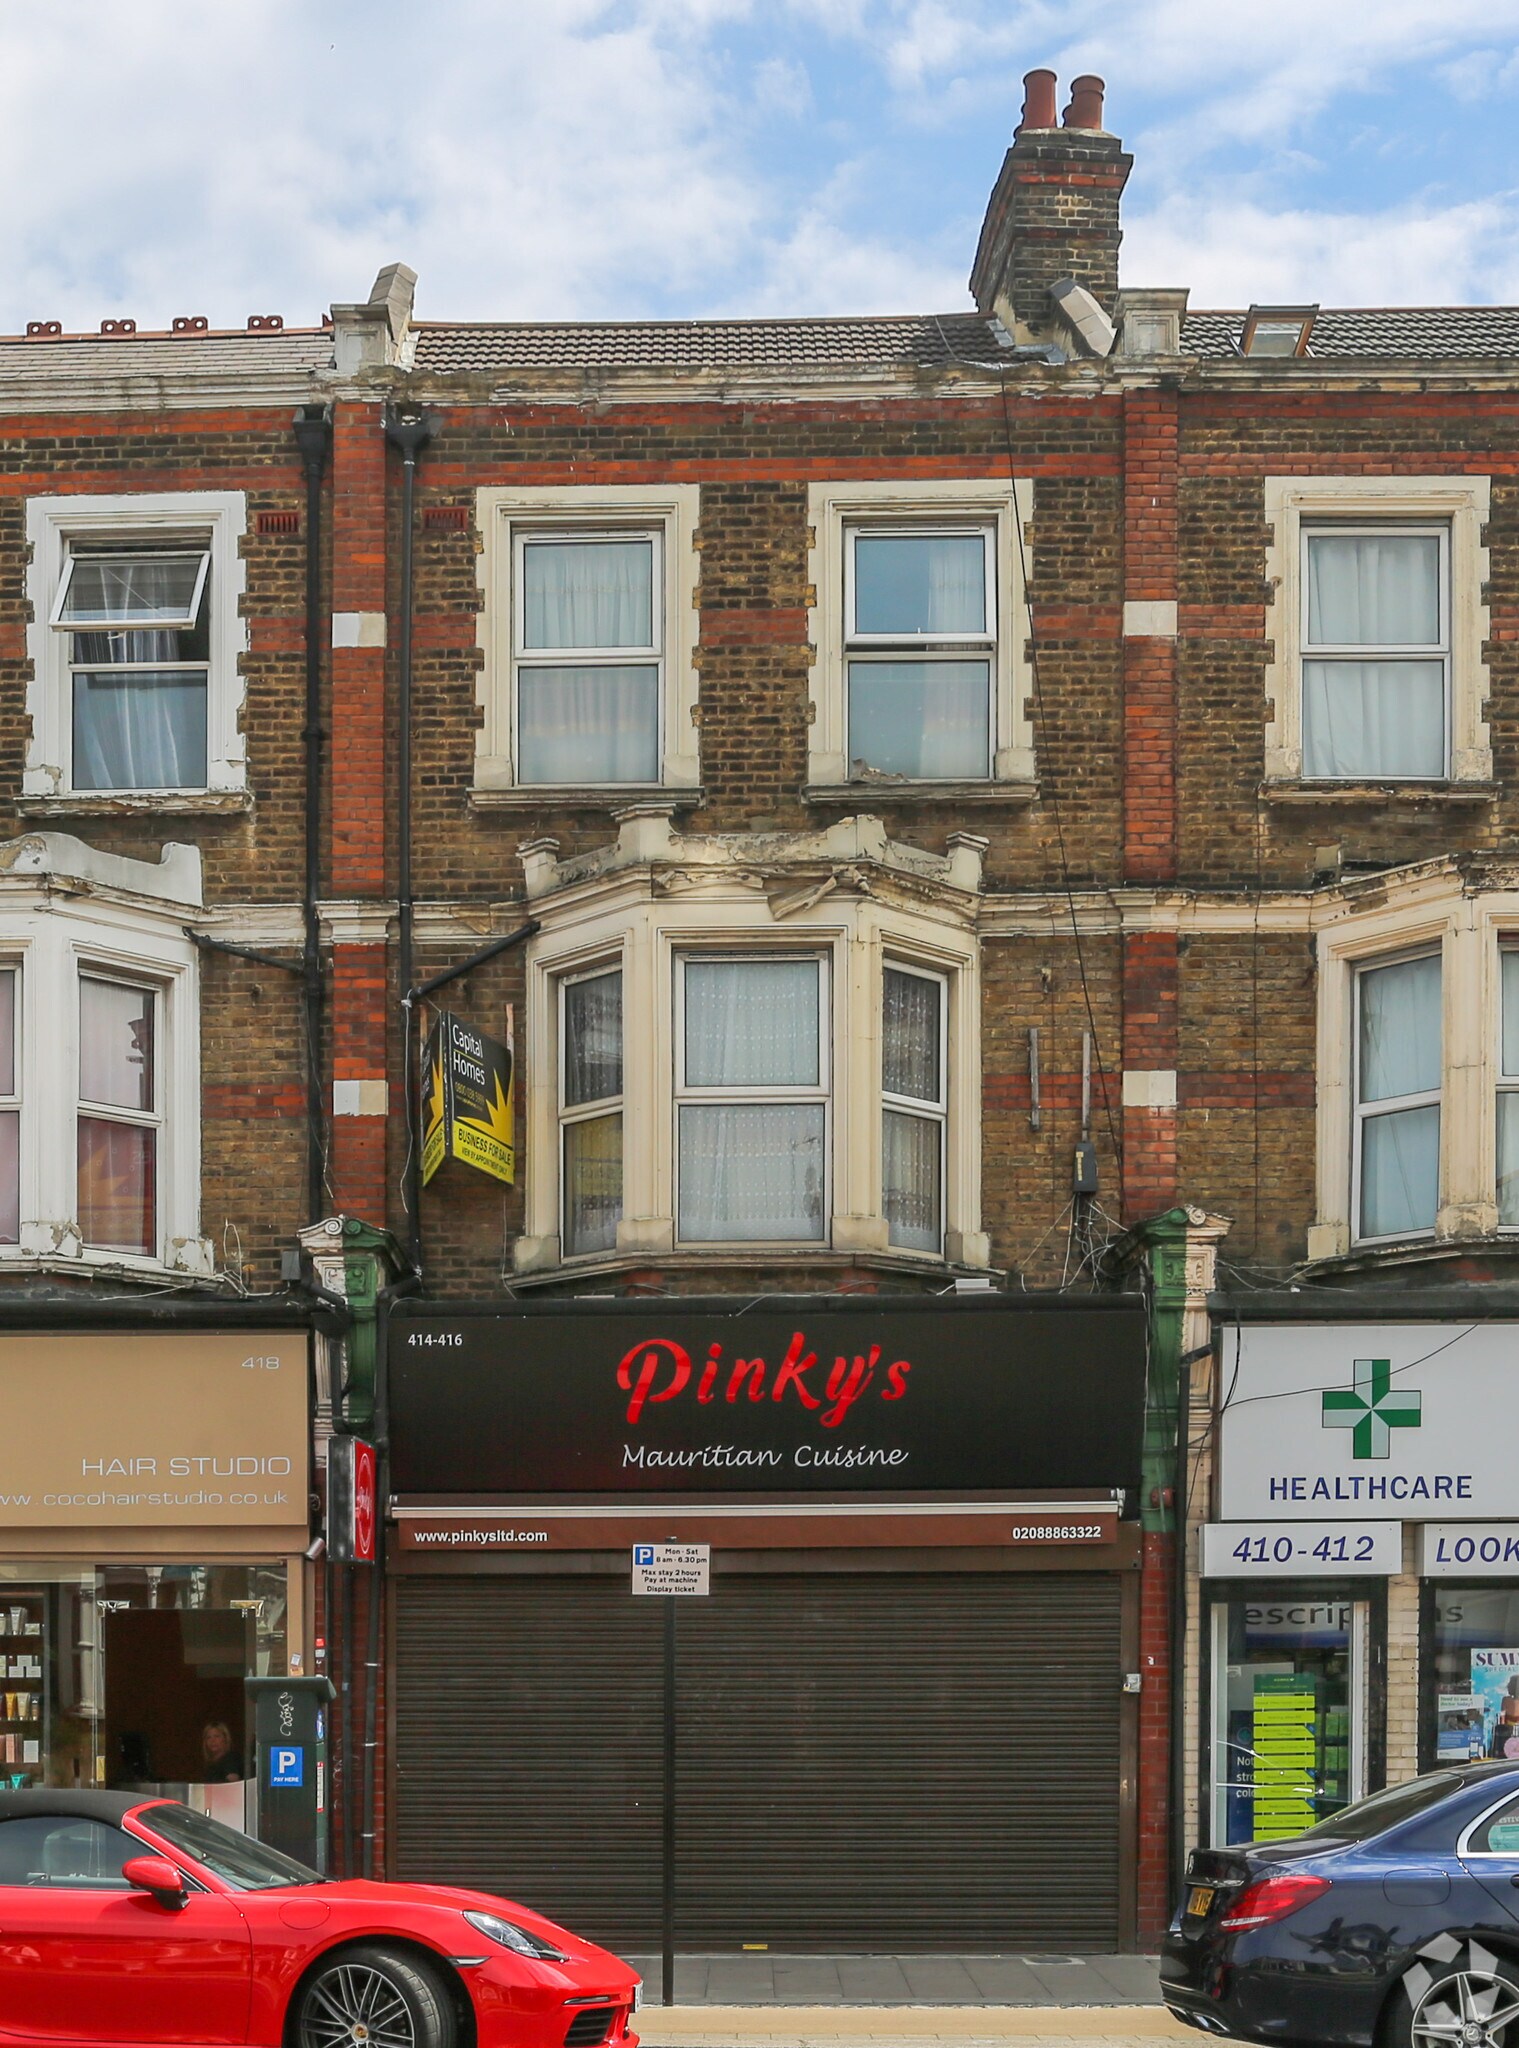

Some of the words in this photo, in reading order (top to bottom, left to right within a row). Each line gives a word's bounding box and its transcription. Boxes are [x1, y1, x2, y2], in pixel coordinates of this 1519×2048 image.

[453, 1024, 483, 1058] Capital
[453, 1052, 486, 1086] Homes
[458, 1128, 488, 1153] BUSINESS
[499, 1148, 511, 1166] SALE
[407, 1333, 463, 1347] 414-416
[241, 1356, 280, 1370] 418
[616, 1332, 911, 1428] Pinky's
[81, 1457, 157, 1476] HAIR
[169, 1457, 291, 1476] STUDIO
[622, 1444, 782, 1469] Mauritian
[794, 1444, 909, 1468] Cuisine
[1269, 1475, 1473, 1500] HEALTHCARE
[414, 1530, 548, 1544] www.pinkysltd.com
[1012, 1526, 1101, 1540] 02088863322
[639, 1548, 652, 1564] P
[1232, 1535, 1375, 1563] 410-412
[1435, 1536, 1519, 1563] LOOK
[658, 1569, 673, 1577] stay
[279, 1751, 296, 1774] P
